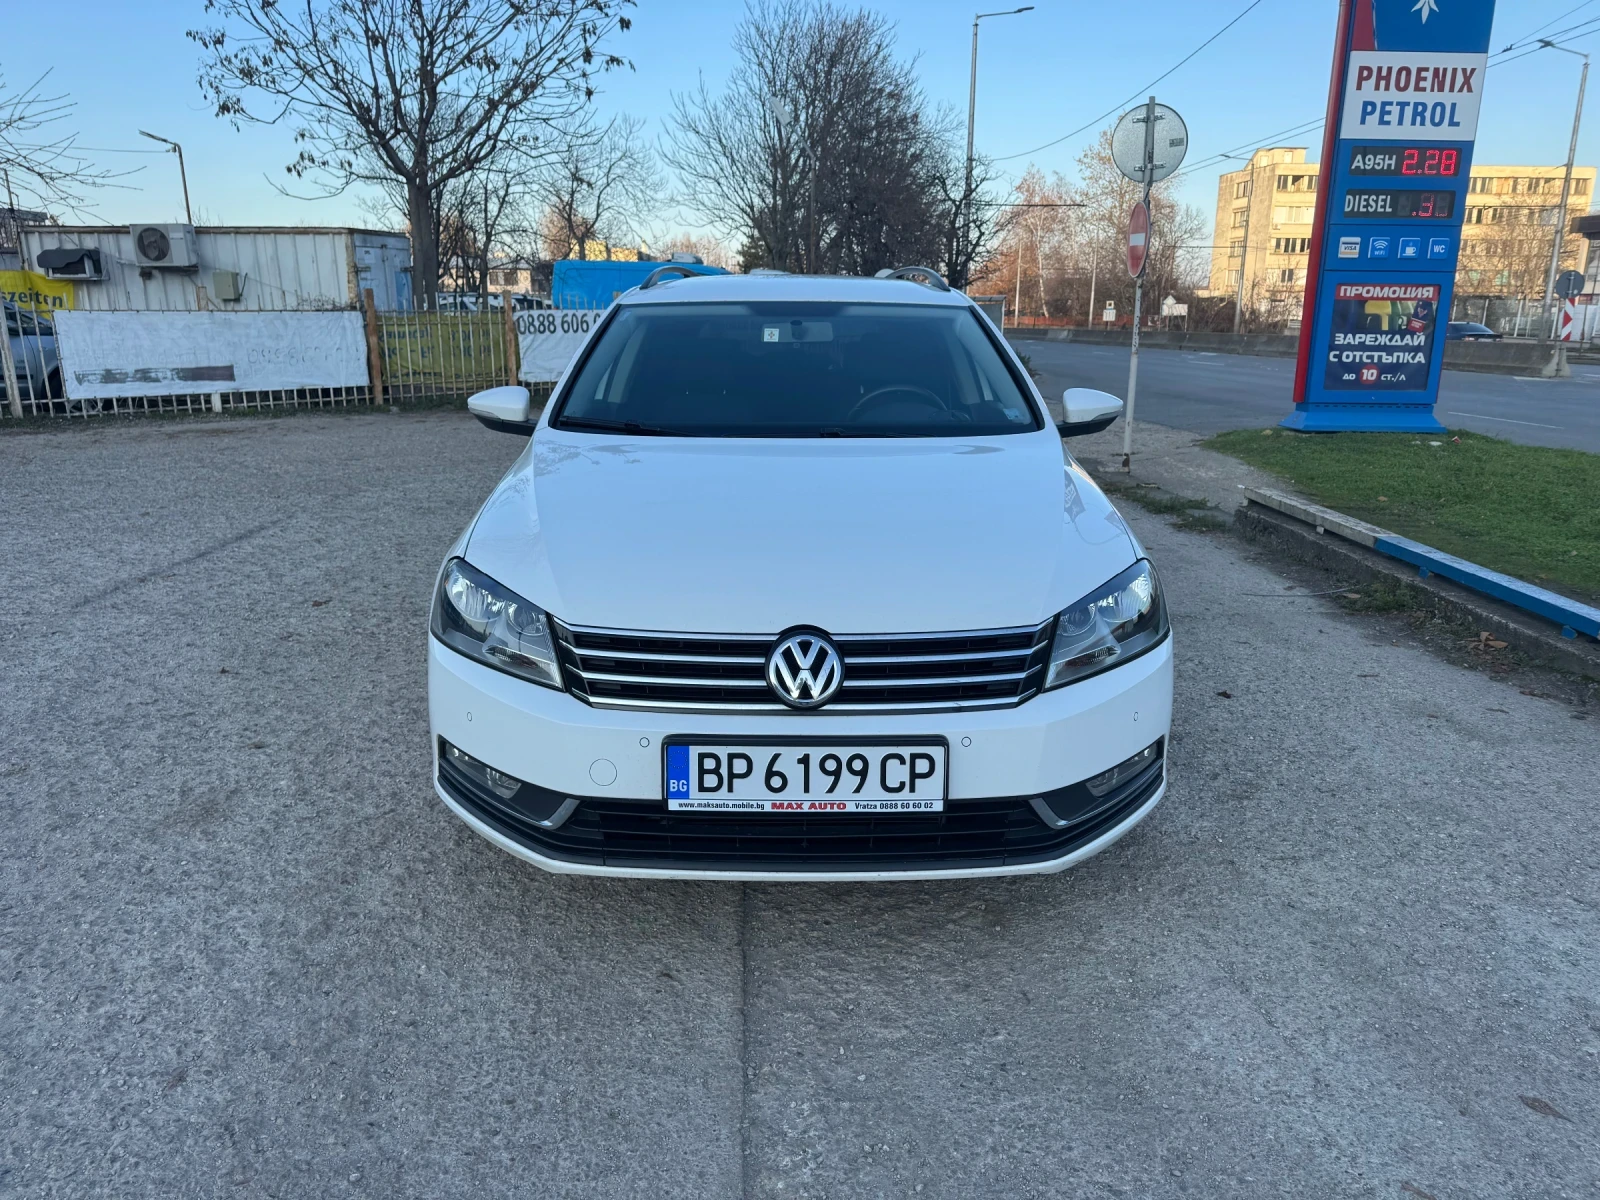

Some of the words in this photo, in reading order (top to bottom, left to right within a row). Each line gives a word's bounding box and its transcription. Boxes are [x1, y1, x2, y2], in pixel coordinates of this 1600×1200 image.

[1355, 65, 1477, 93] PHOENIX
[1359, 100, 1461, 127] PETROL
[1351, 154, 1397, 170] A95H
[1401, 149, 1457, 175] 2.28
[1344, 194, 1392, 212] DIESEL
[1433, 244, 1446, 253] WC
[1339, 285, 1434, 299] ПРОМОЦИЯ
[516, 313, 557, 335] 0888
[561, 313, 590, 334] 606
[1334, 332, 1426, 346] ЗАРЕЖДАЙ
[1329, 351, 1340, 362] С
[1342, 351, 1426, 364] ОТСТЪПКА
[1361, 369, 1378, 381] 10
[697, 752, 754, 793] BP
[764, 752, 870, 794] 6199
[880, 752, 936, 793] CP
[669, 779, 688, 792] BG
[678, 801, 765, 811] www.maksauto.mobile.bg
[771, 802, 804, 810] MAX
[808, 802, 847, 811] AUTO
[855, 802, 878, 810] Vratza
[880, 802, 899, 810] 0888
[901, 802, 911, 810] 60
[912, 802, 922, 810] 60
